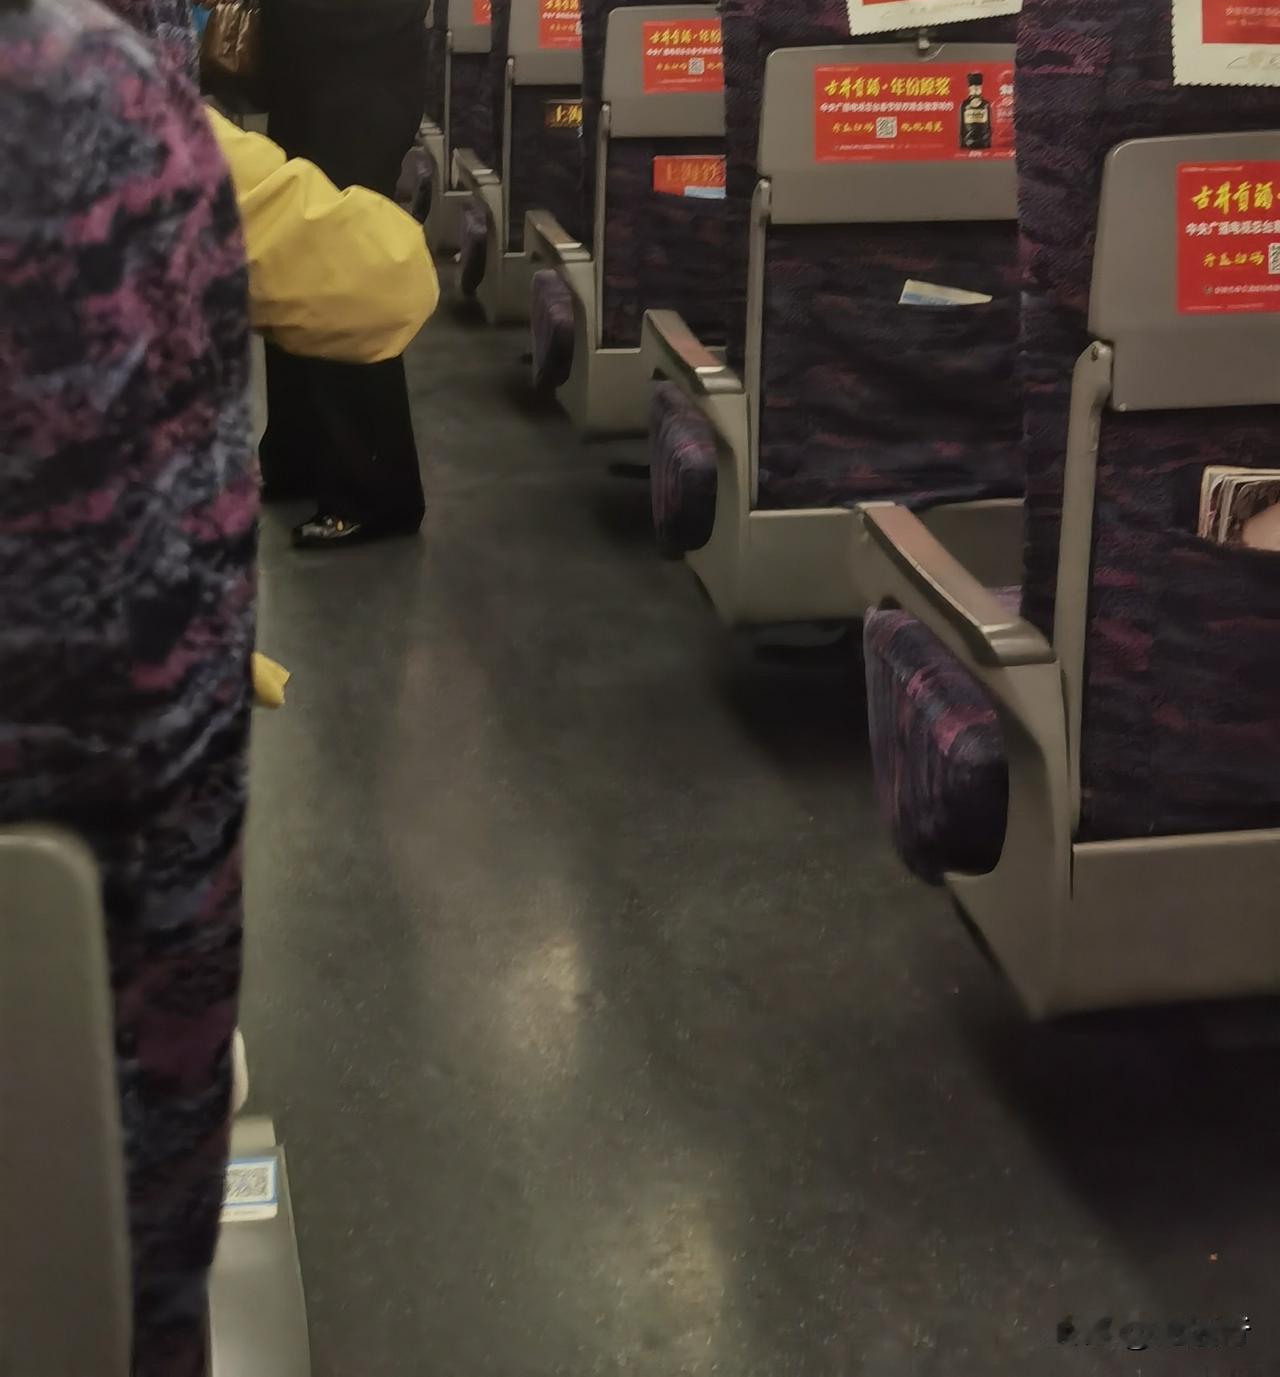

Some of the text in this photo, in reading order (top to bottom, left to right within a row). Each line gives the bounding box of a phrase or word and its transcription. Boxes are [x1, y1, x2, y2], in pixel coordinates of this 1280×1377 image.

[823, 76, 951, 99] 古井贡酒·年份原浆
